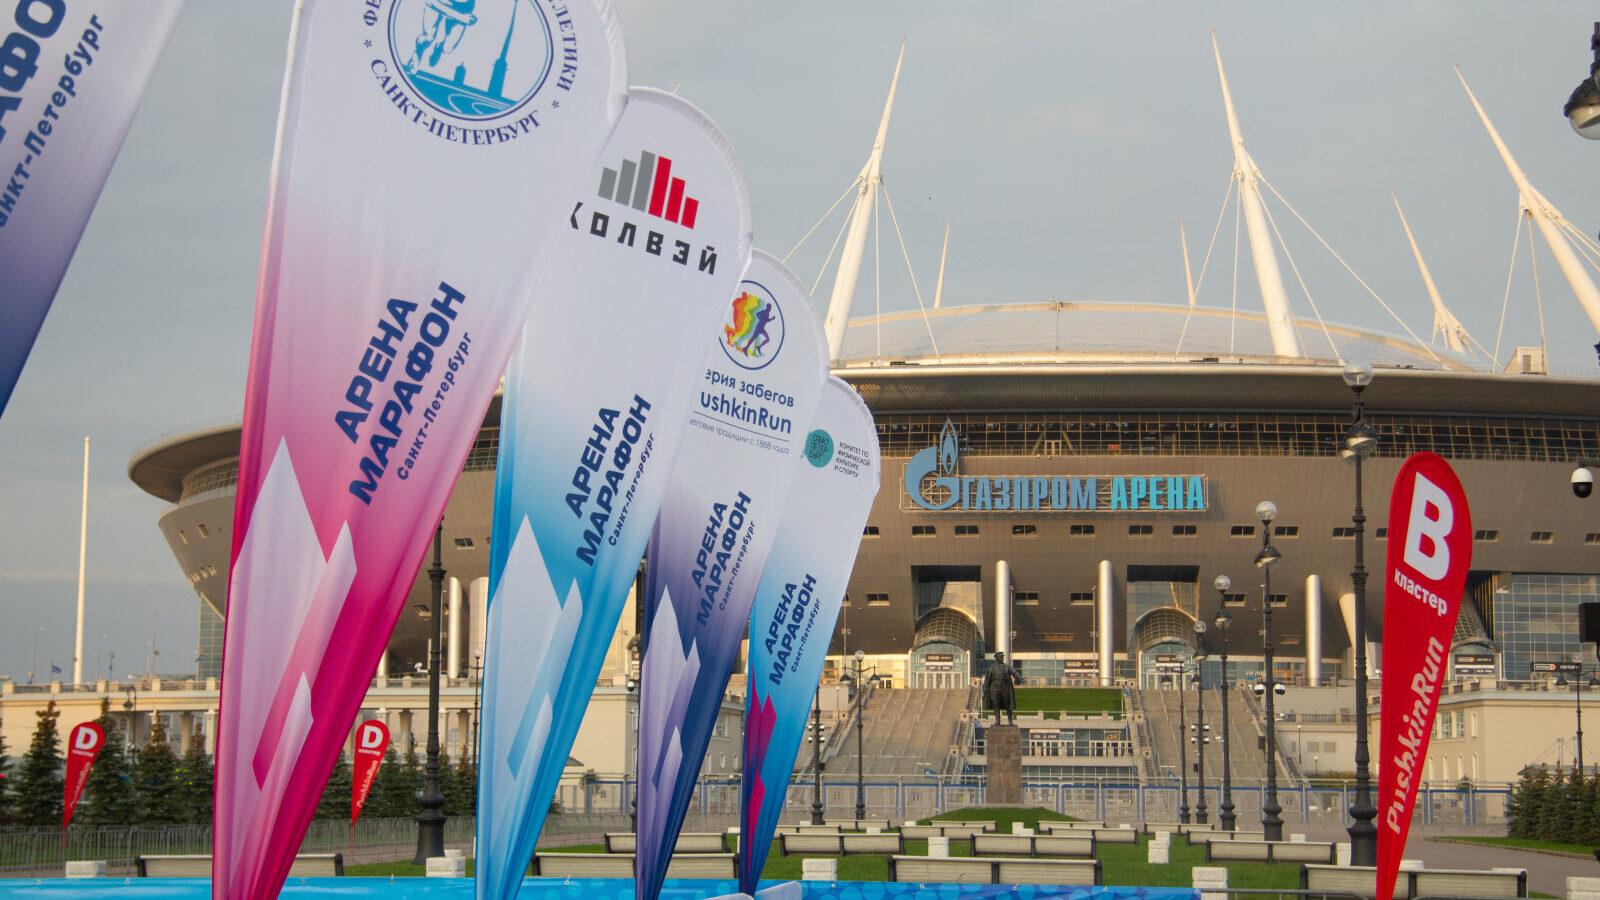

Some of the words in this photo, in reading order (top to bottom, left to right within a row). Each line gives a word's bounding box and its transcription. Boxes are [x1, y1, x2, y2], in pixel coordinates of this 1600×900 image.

[370, 58, 541, 146] САНКТ-ПЕТЕРБУРГ
[335, 298, 419, 444] АРЕНА
[349, 281, 466, 506] МАРАФОН
[397, 332, 472, 480] Санкт-Петербург
[739, 381, 794, 407] забегов
[701, 391, 792, 434] ushkinRun
[756, 439, 772, 450] 1888
[839, 442, 861, 455] КОМИТЕТ
[861, 450, 870, 458] ПО
[565, 408, 620, 519] АРЕНА
[576, 394, 651, 567] МАРАФОН
[608, 432, 655, 546] Санкт-Петербург
[835, 457, 860, 470] КУЛЬТУРЕ
[837, 449, 871, 467] ФИЗИЧЕСКОЙ
[838, 466, 859, 478] СПОРТУ
[962, 477, 1097, 510] ГАЗПРОМ
[1110, 476, 1205, 510] АРЕНА
[691, 502, 728, 589] АРЕНА
[697, 491, 751, 627] МАРАФОН
[719, 520, 755, 611] Санкт-Петербург
[765, 582, 798, 655] АРЕНА
[769, 573, 817, 686] МАРАФОН
[1394, 568, 1448, 617] кластер
[791, 598, 821, 673] Санкт-Петербург
[75, 726, 98, 750] D
[361, 725, 384, 748] D
[1386, 636, 1444, 834] PushkinRun
